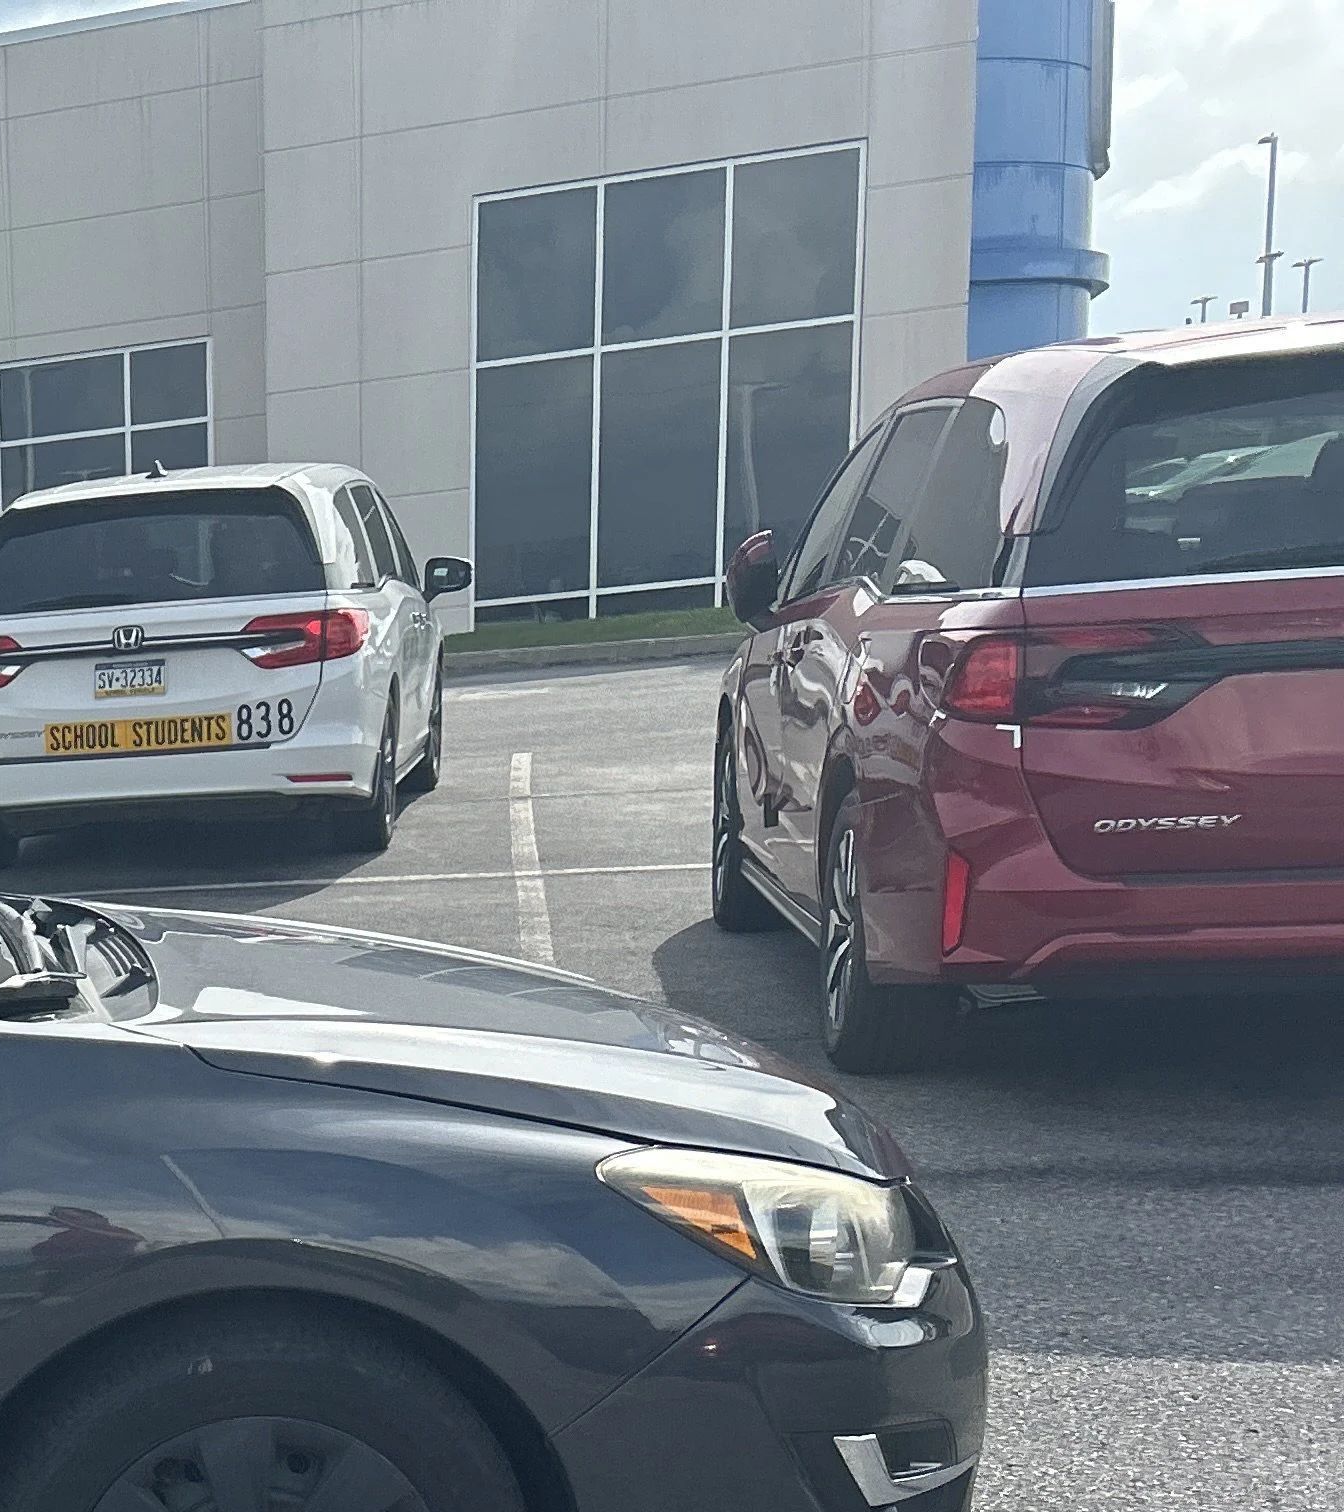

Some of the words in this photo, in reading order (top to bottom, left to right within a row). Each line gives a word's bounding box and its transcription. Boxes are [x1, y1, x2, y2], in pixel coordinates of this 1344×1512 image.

[49, 722, 120, 751] SCHOOL
[132, 714, 226, 747] STUDENTS
[236, 698, 294, 741] 838
[1093, 813, 1243, 834] ODYSSEY
